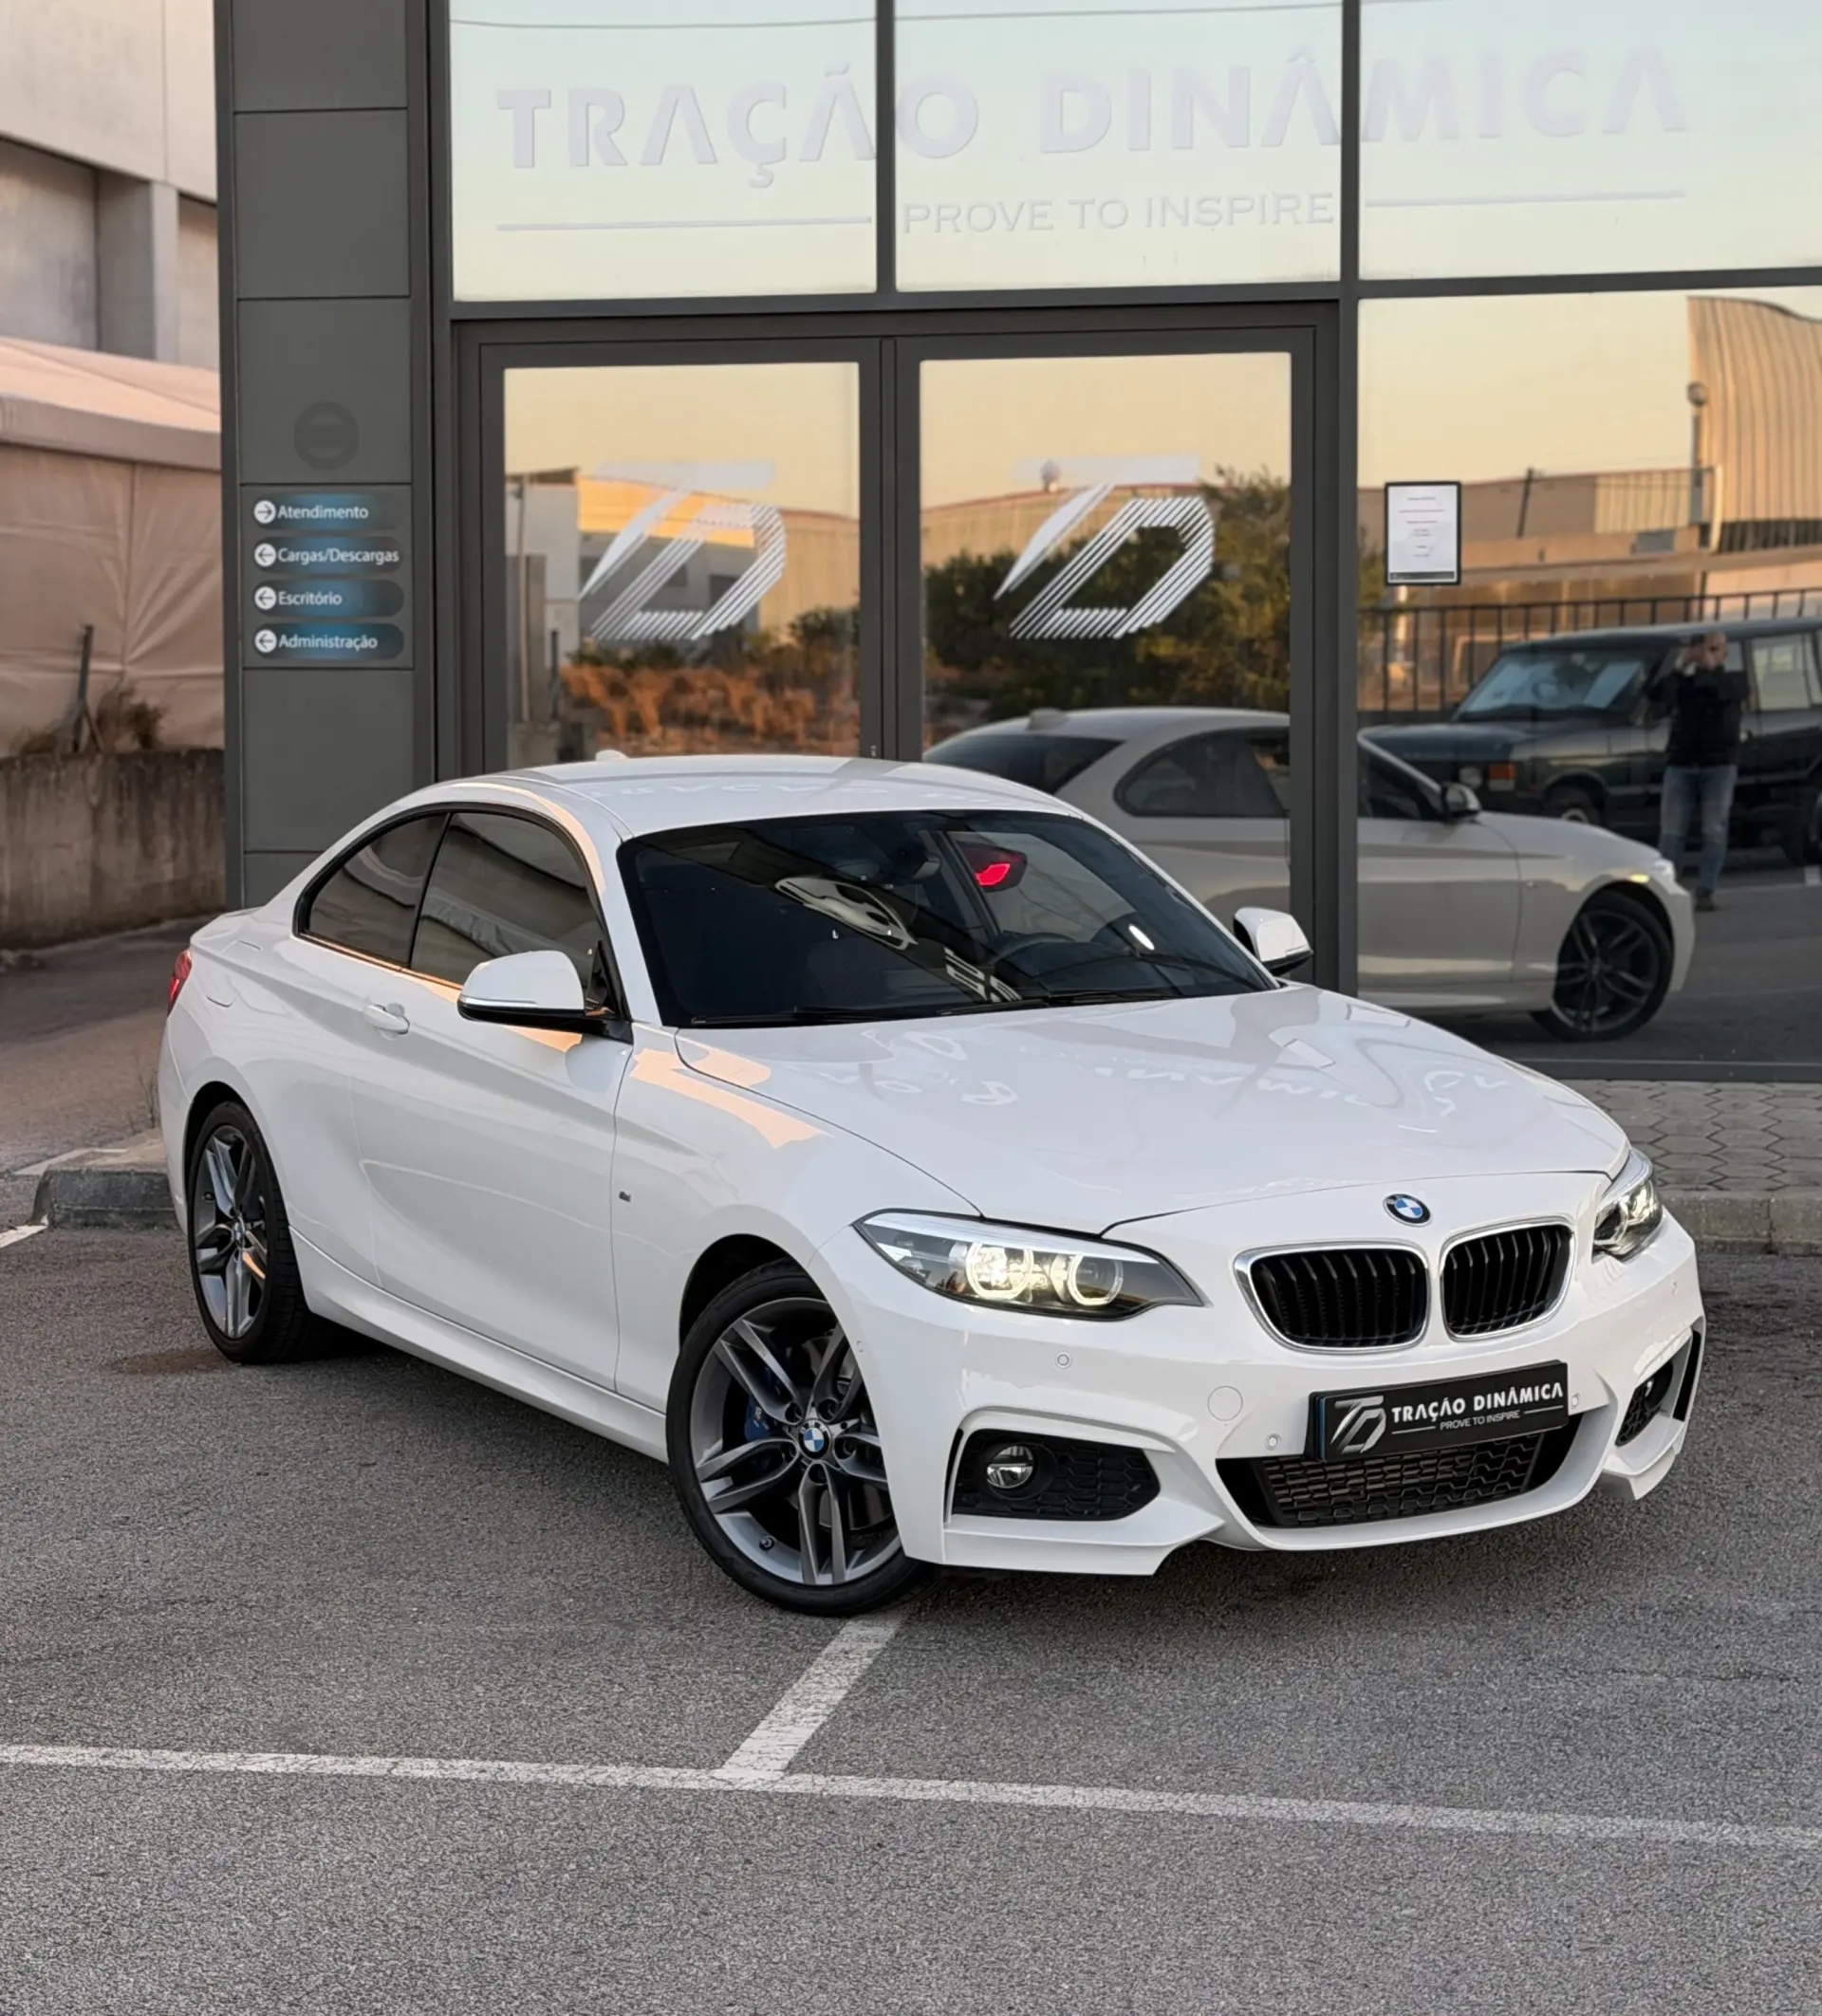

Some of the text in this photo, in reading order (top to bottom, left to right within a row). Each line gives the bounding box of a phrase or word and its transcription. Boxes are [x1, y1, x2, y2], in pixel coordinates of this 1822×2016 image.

[496, 45, 1688, 189] TRAÇÃO DINÂMICA
[902, 192, 1334, 234] PROVE TO INSPIRE
[278, 505, 369, 521] Atendimento
[278, 546, 400, 565] Cargas/Descargas
[278, 590, 343, 605] Escritório
[278, 633, 378, 652] Administração
[1391, 1381, 1564, 1423] TRAÇÃO DINÂMICA
[1440, 1410, 1521, 1431] PROVE TO INSPIRE
